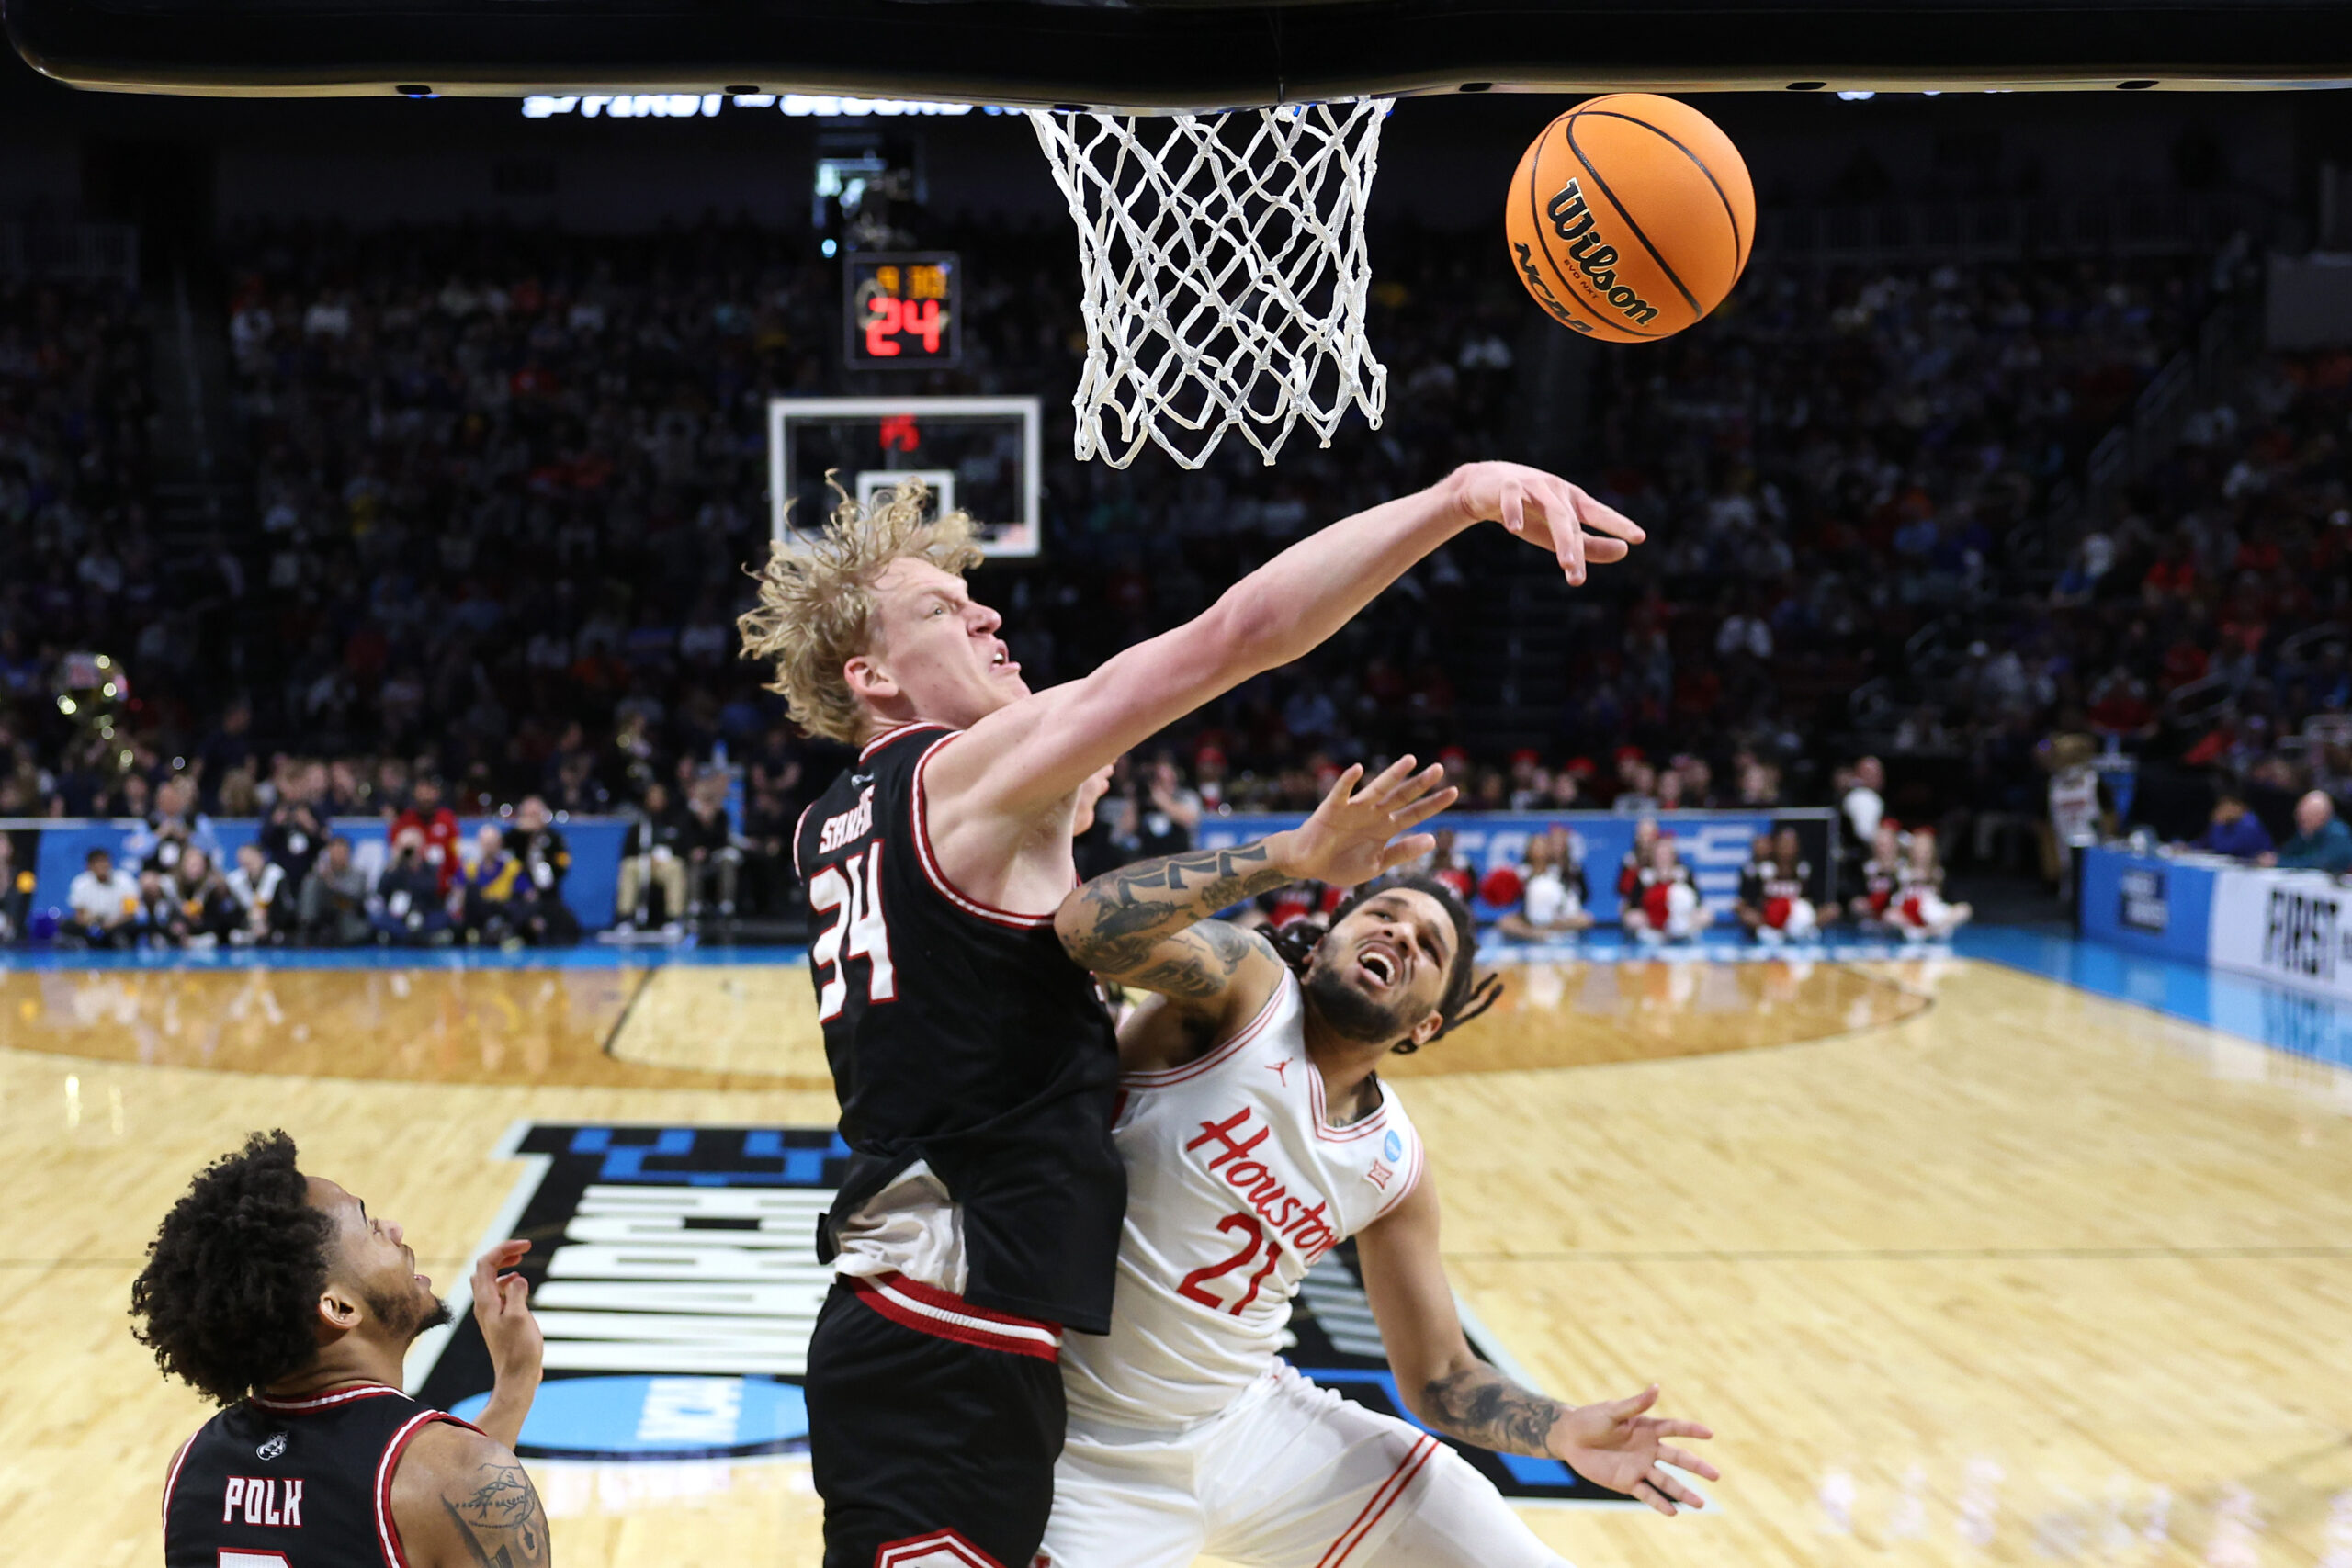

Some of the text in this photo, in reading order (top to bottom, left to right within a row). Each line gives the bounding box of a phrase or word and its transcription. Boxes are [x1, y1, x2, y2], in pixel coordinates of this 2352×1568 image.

[1514, 242, 1596, 333] NCAA
[1547, 177, 1660, 327] Wilson
[1564, 258, 1600, 299] EVO NXT
[865, 296, 941, 356] 24
[809, 838, 899, 1024] 34
[1176, 1211, 1283, 1317] 21
[222, 1475, 305, 1528] POLK
